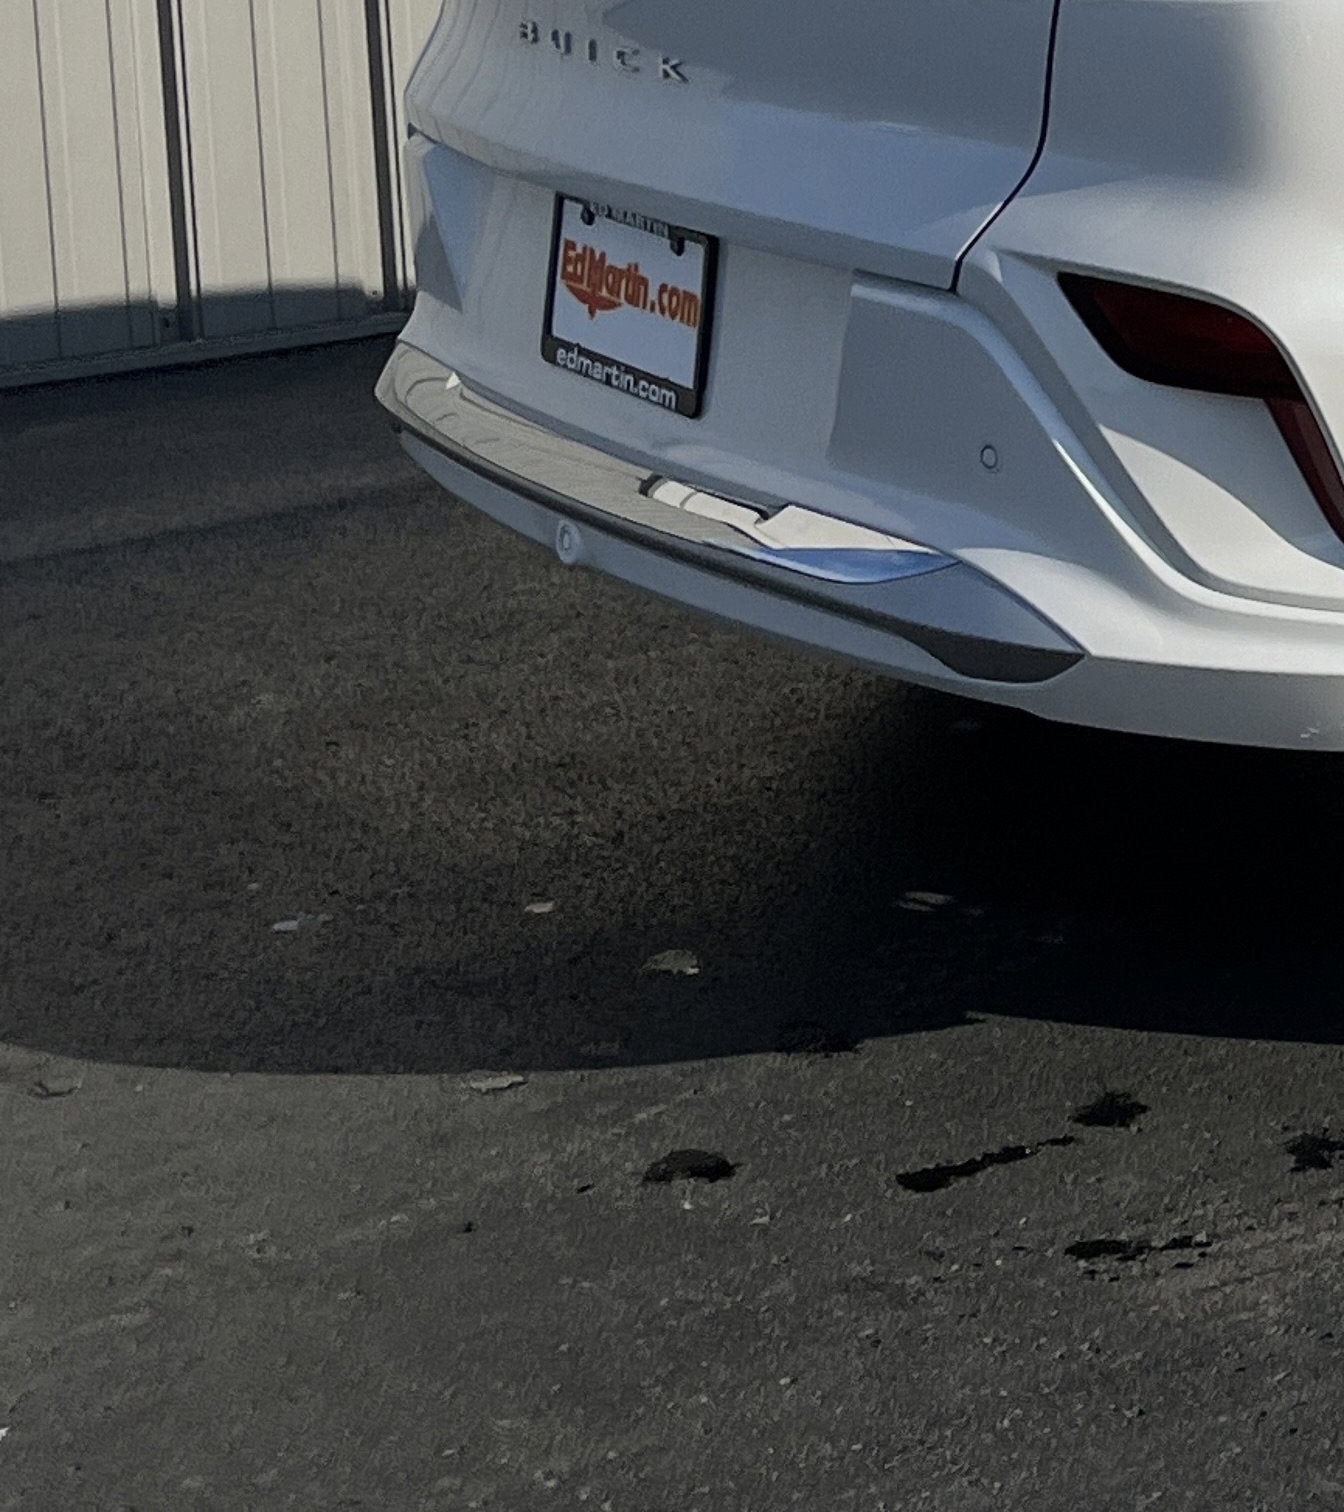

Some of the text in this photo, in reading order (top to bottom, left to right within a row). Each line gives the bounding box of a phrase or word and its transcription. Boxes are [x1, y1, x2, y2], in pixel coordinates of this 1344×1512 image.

[519, 21, 690, 84] BUICK
[561, 238, 699, 328] EdMartin.com
[556, 345, 677, 410] edmartin.com
